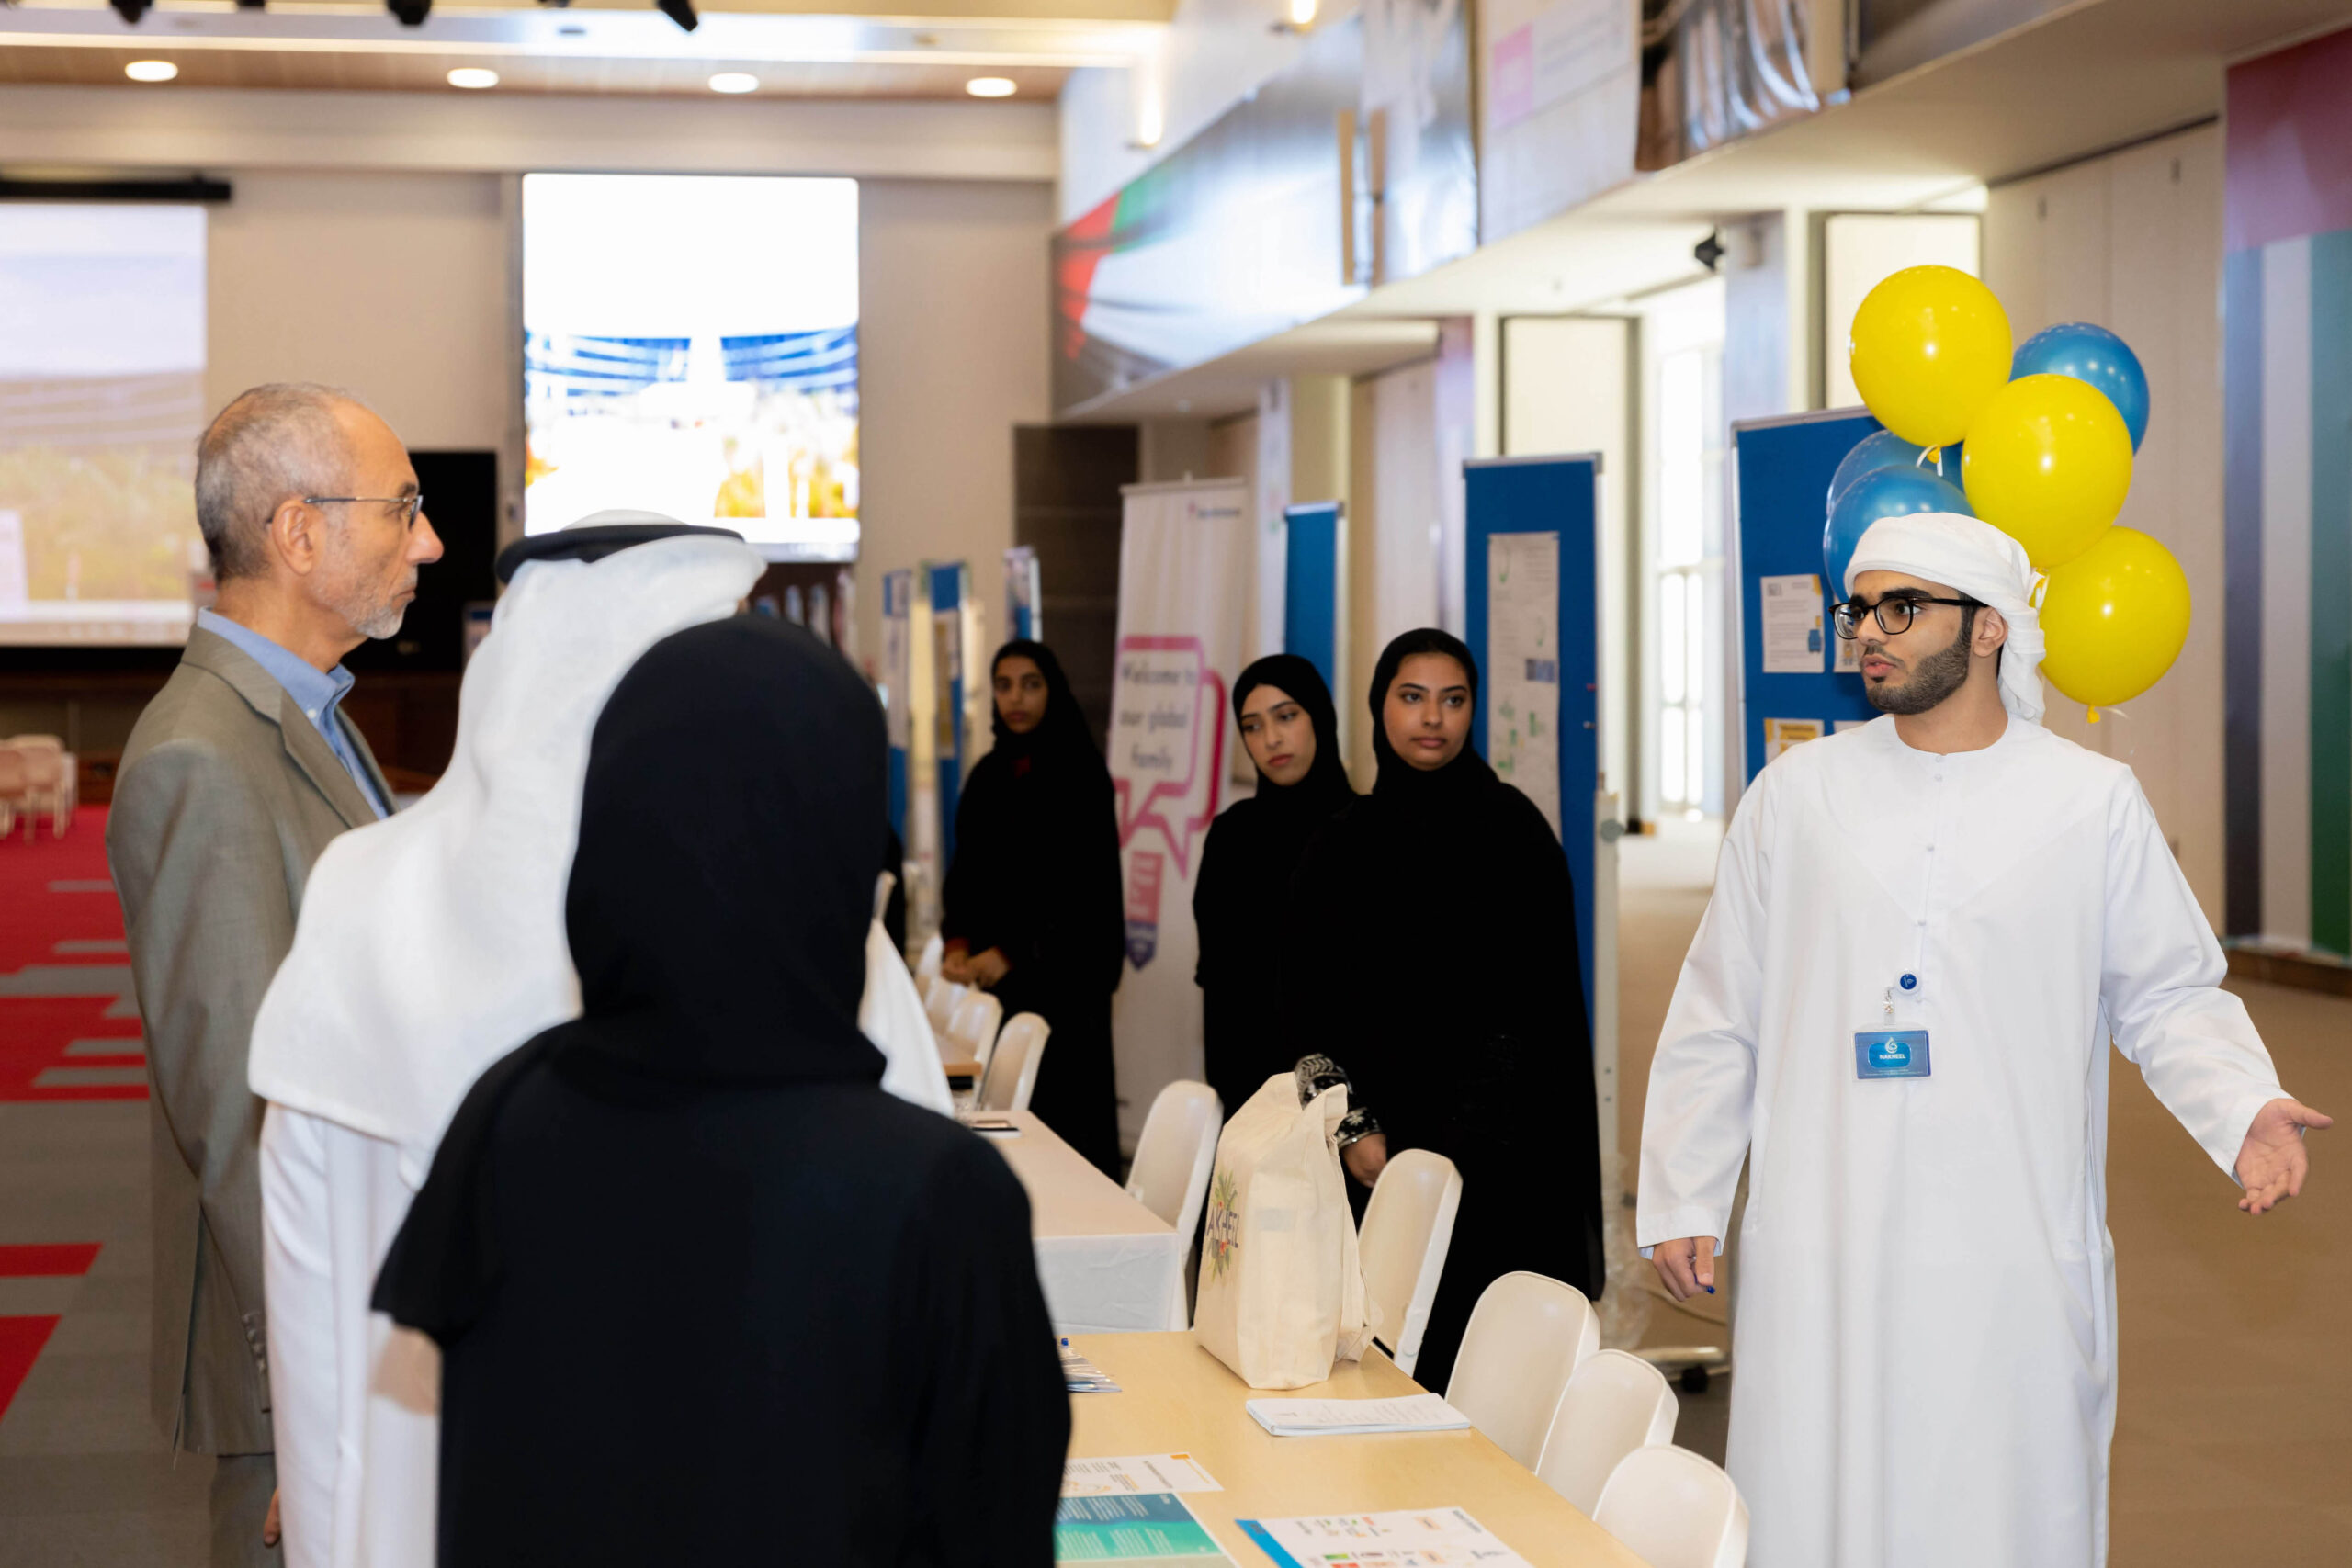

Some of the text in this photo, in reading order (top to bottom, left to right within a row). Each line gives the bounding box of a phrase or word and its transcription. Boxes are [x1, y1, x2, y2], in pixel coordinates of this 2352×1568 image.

[1122, 660, 1180, 684] Welcome
[1120, 701, 1190, 734] our global
[1131, 743, 1173, 775] family
